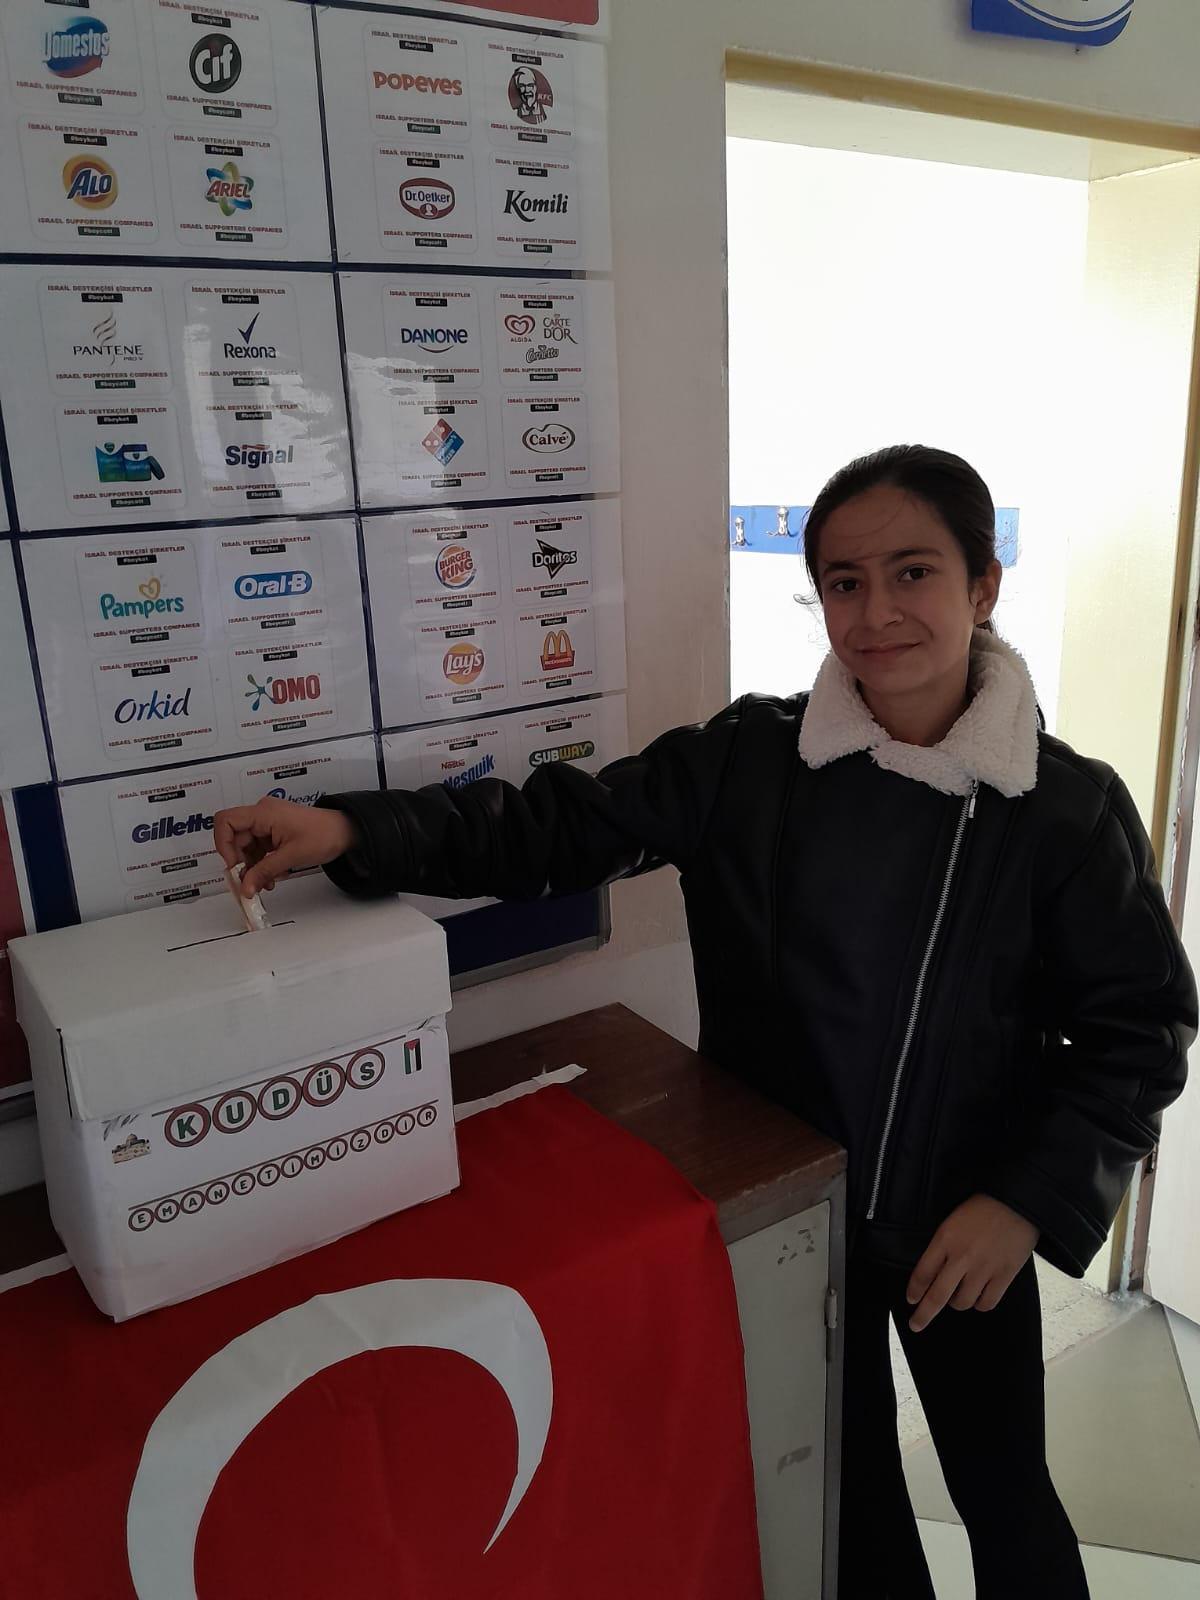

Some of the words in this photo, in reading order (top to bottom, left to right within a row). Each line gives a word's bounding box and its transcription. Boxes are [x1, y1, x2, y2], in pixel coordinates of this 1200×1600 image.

[195, 44, 233, 84] Cif
[504, 189, 568, 222] Komili
[543, 318, 570, 327] CARTE
[73, 345, 143, 355] PANTENE
[224, 343, 276, 358] Rexona
[529, 432, 566, 445] Calvé
[226, 445, 293, 468] Signal
[440, 551, 470, 570] BURGER
[441, 559, 473, 582] KING
[534, 552, 576, 566] Doritos
[240, 574, 306, 596] Oral-B
[100, 594, 184, 620] Pampers
[272, 675, 320, 704] OMO
[115, 688, 191, 723] Orkid
[531, 743, 592, 765] SUBWAY
[132, 813, 214, 843] Gillette
[177, 1062, 375, 1140] KUDÜS
